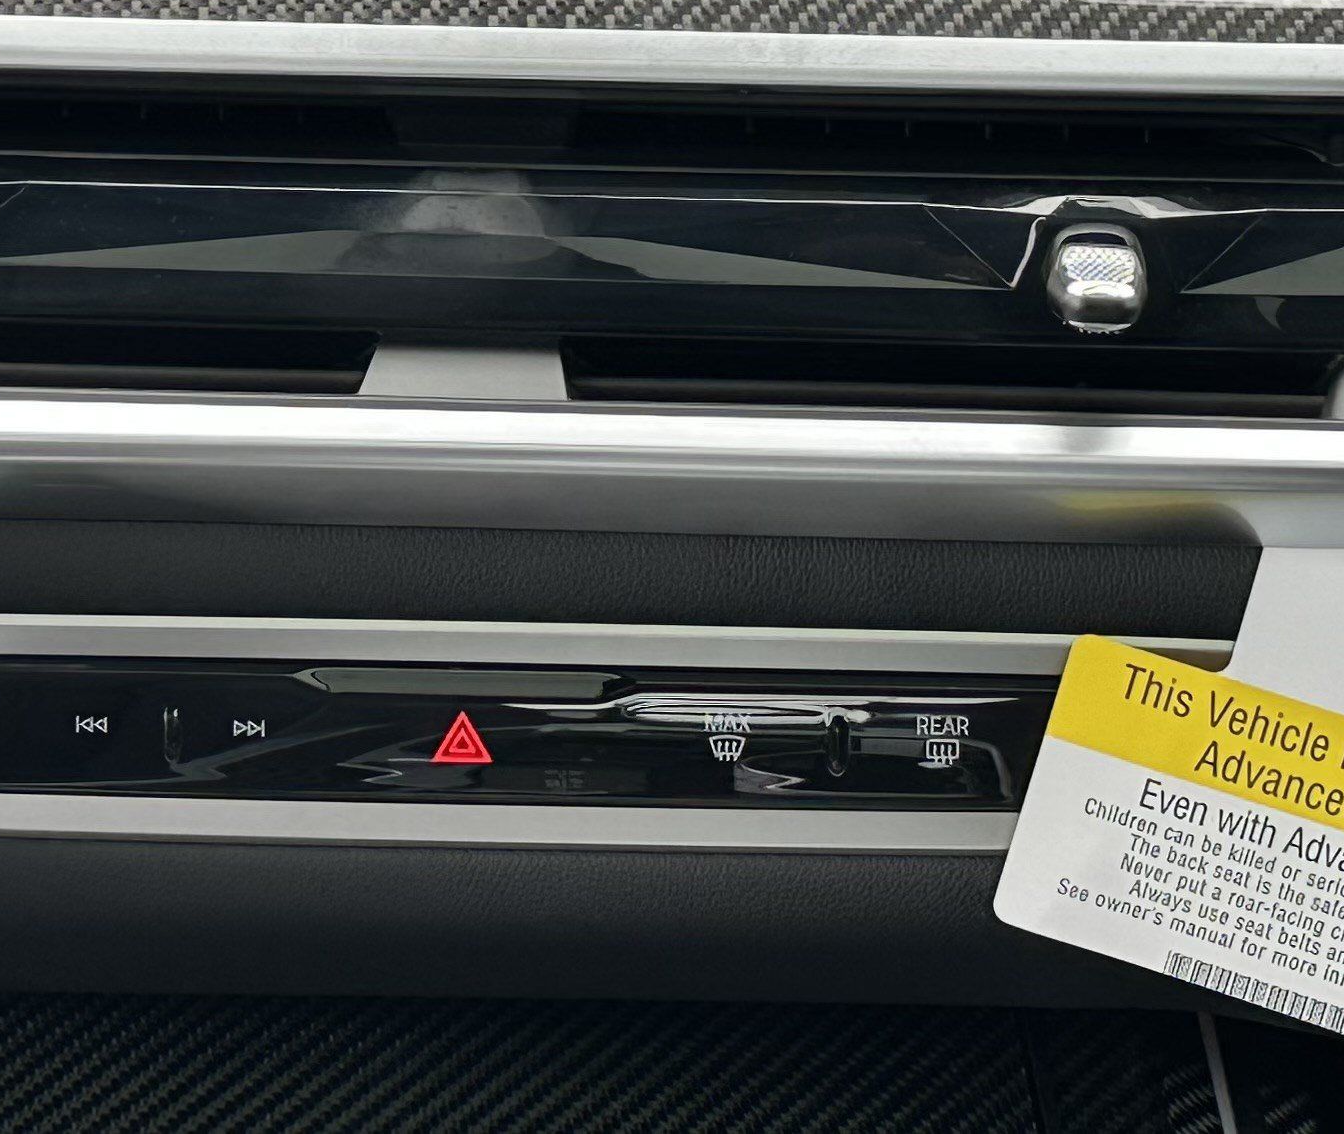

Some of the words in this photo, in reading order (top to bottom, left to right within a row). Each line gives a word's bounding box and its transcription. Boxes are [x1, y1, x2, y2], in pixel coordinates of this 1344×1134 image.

[916, 714, 970, 737] REAR
[1124, 663, 1194, 718] This
[1209, 689, 1330, 762] Vehicle
[1084, 797, 1158, 836] Children
[1163, 826, 1195, 848] can
[1201, 834, 1222, 857] be
[1227, 843, 1277, 874] killed
[1281, 865, 1301, 882] or
[1139, 777, 1208, 827] Even
[1217, 808, 1277, 849] with
[1119, 852, 1173, 884] Never
[1175, 874, 1207, 897] put
[1211, 886, 1222, 901] a
[1227, 891, 1325, 938] rear-facing
[1130, 832, 1161, 859] The
[1167, 845, 1209, 875] back
[1212, 864, 1251, 889] seat
[1256, 875, 1272, 895] is
[1278, 882, 1306, 906] the
[1056, 877, 1089, 902] See
[1095, 893, 1164, 926] owner's
[1169, 917, 1236, 948] manual
[1240, 936, 1267, 960] for
[1271, 950, 1317, 977] more
[1129, 879, 1192, 913] Always
[1197, 903, 1230, 925] use
[1234, 916, 1273, 941] seat
[1277, 926, 1322, 956] belts
